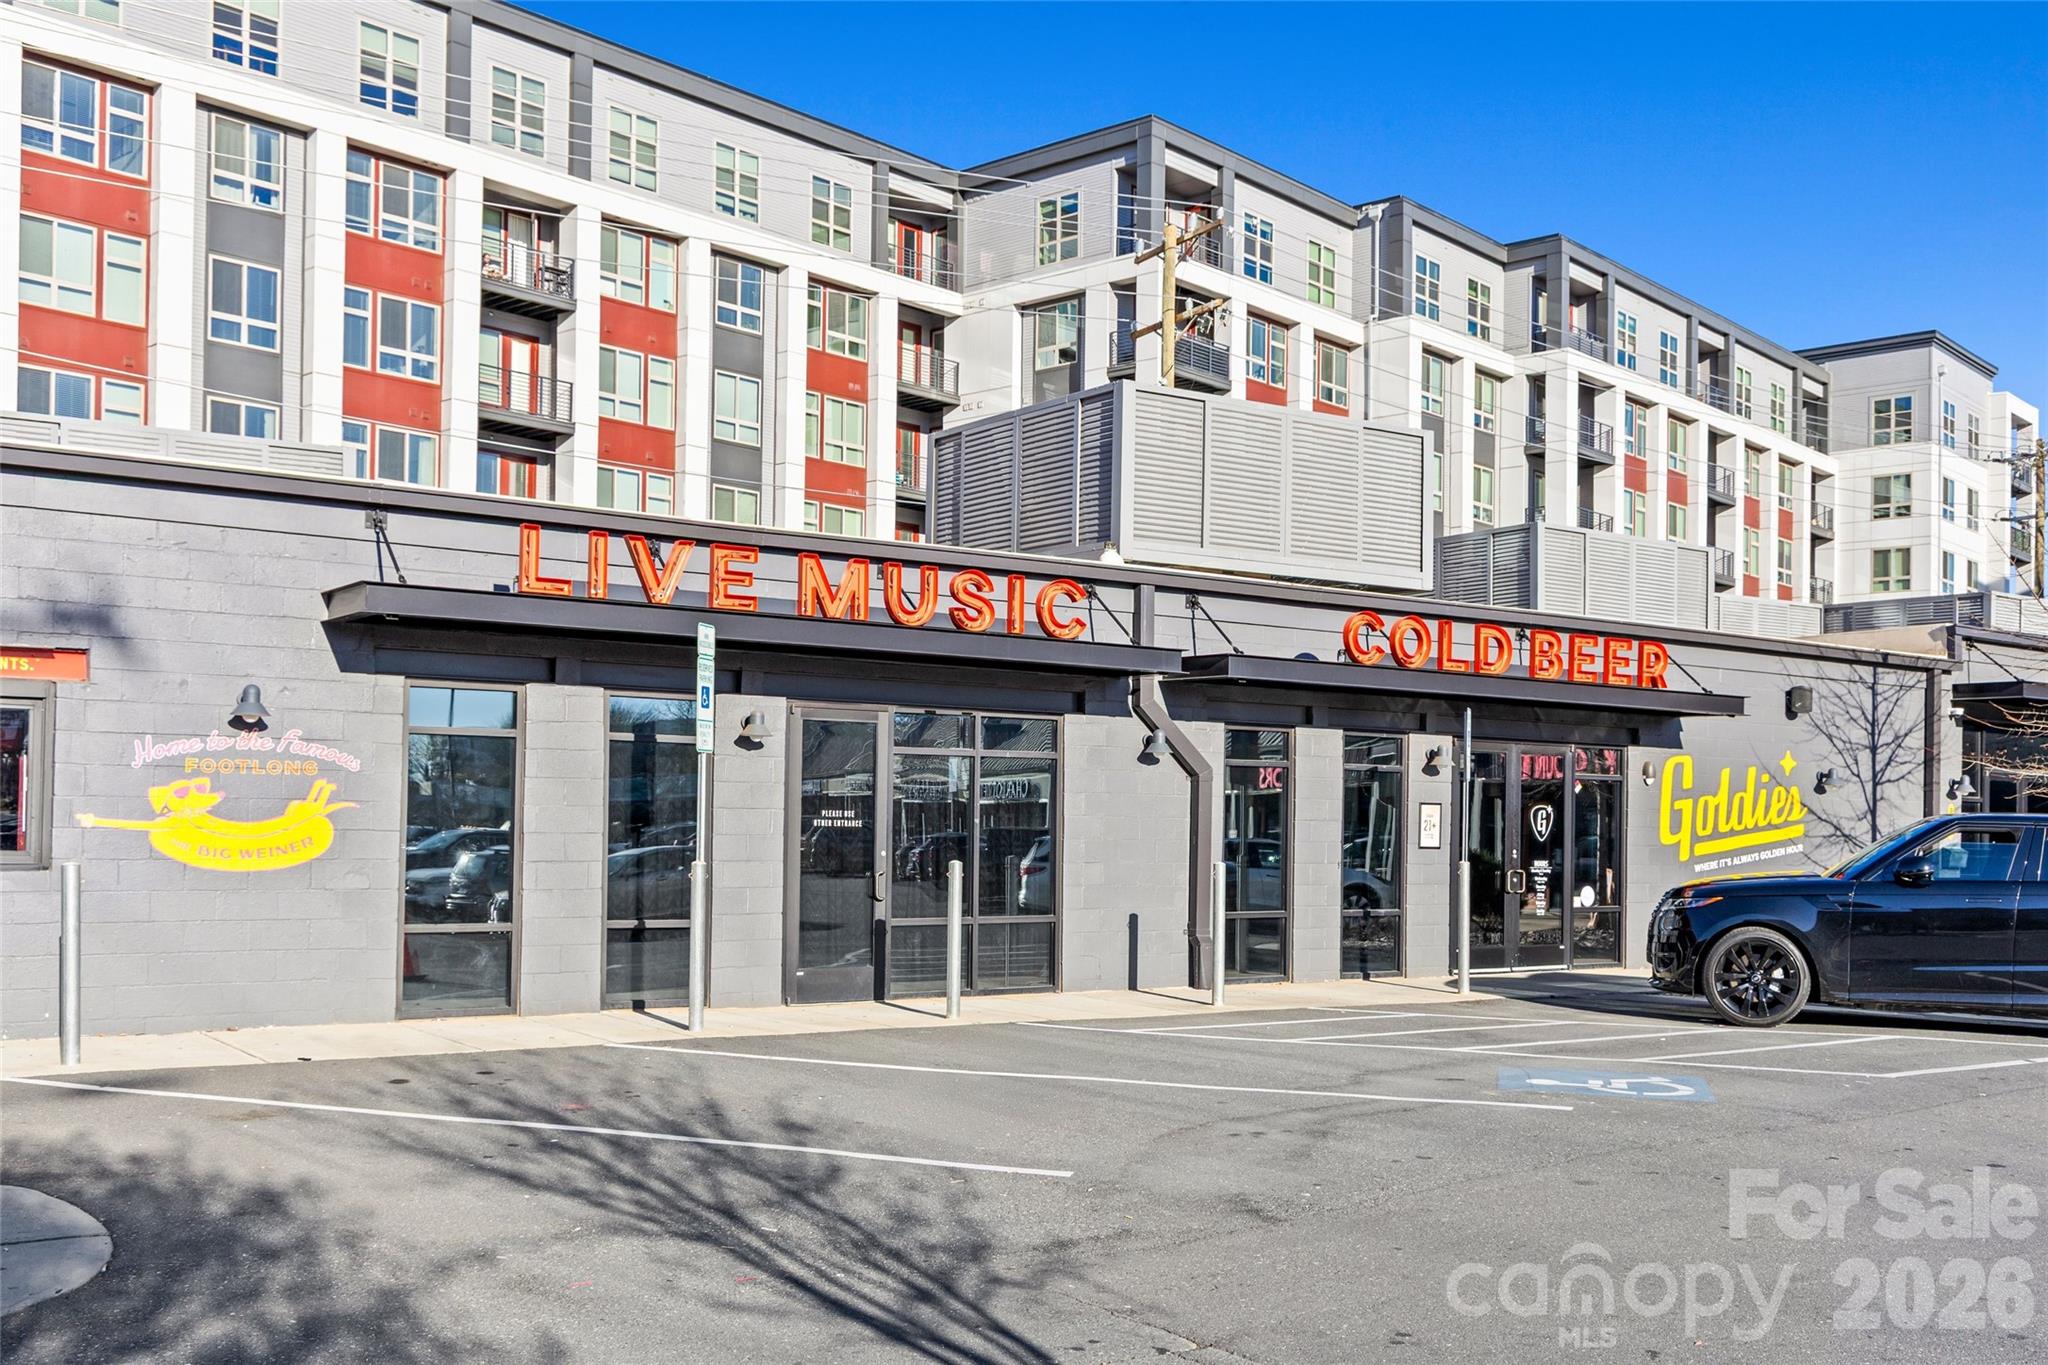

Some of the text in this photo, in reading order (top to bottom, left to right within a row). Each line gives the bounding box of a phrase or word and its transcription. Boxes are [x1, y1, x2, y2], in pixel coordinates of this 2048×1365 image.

[519, 523, 1087, 640] LIVE MUSIC
[1343, 611, 1667, 689] COLD BEER
[131, 728, 361, 772] Home to the Famous
[184, 757, 319, 776] FOOTLONG
[813, 819, 863, 828] OTHER ENTRANCE
[821, 809, 856, 818] PLEASE USE
[1537, 809, 1547, 835] G
[197, 836, 314, 859] BIG WEINER
[1694, 843, 1804, 873] WHERE IT'S ALWAYS GOLDEN HOUR
